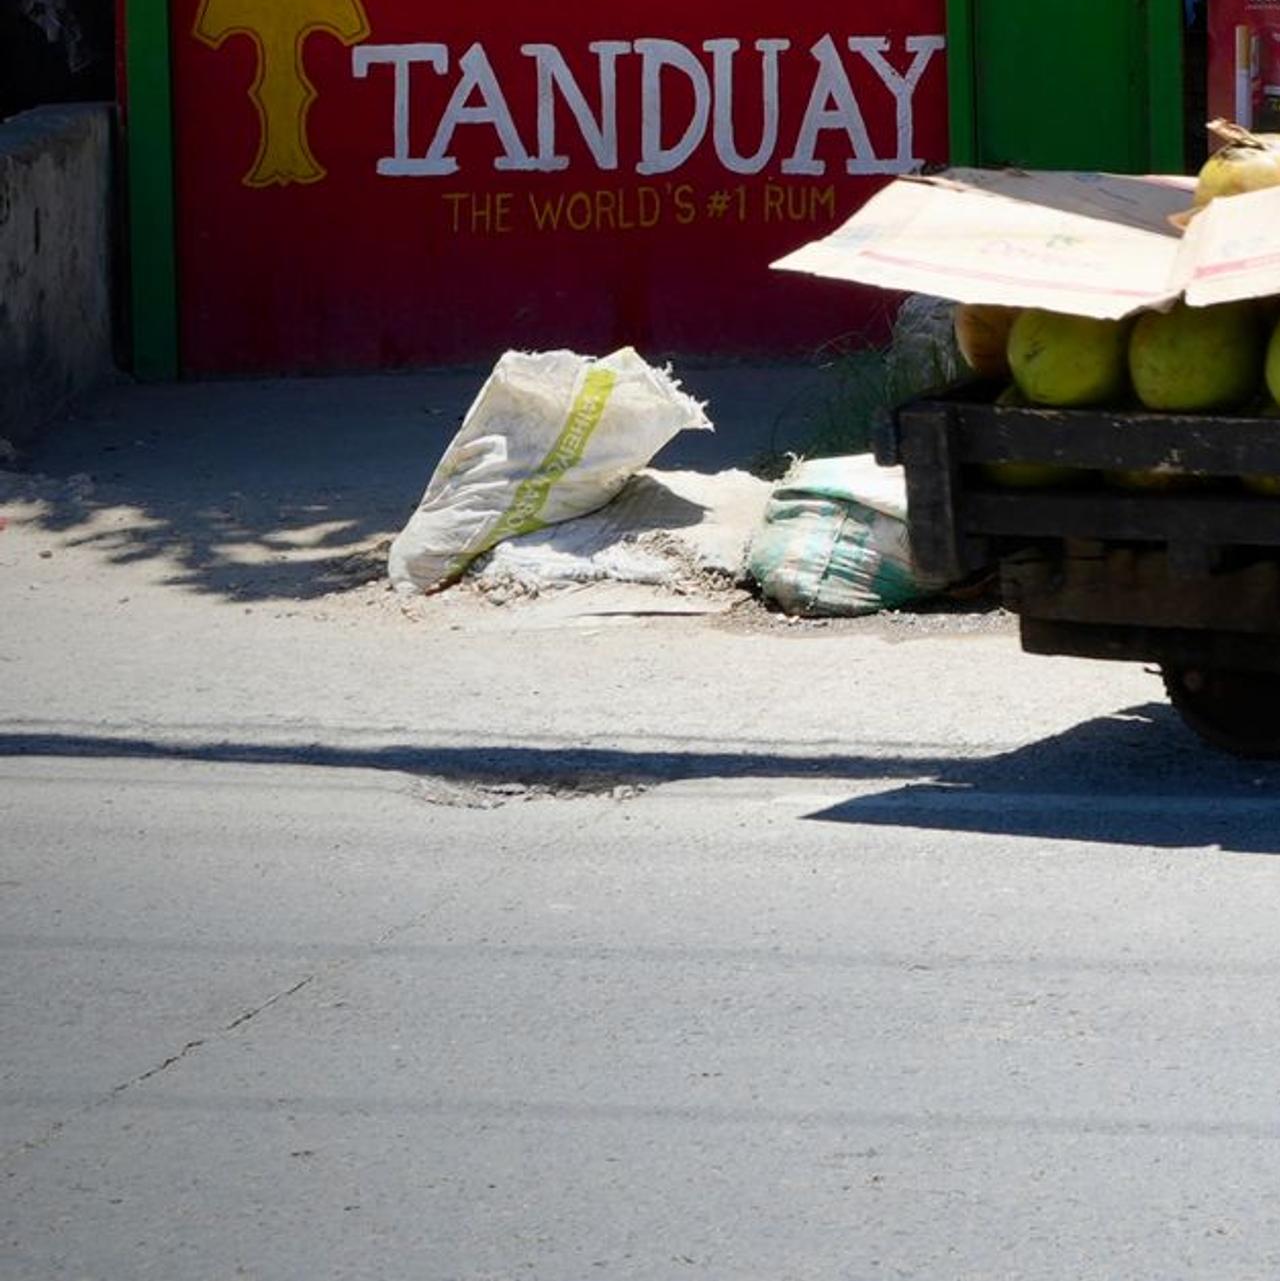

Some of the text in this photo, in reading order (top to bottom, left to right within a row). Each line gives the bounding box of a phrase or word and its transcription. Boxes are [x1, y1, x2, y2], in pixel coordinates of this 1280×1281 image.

[350, 32, 946, 177] TANDUAY
[442, 183, 836, 234] THE WORLD'S #1 RUM
